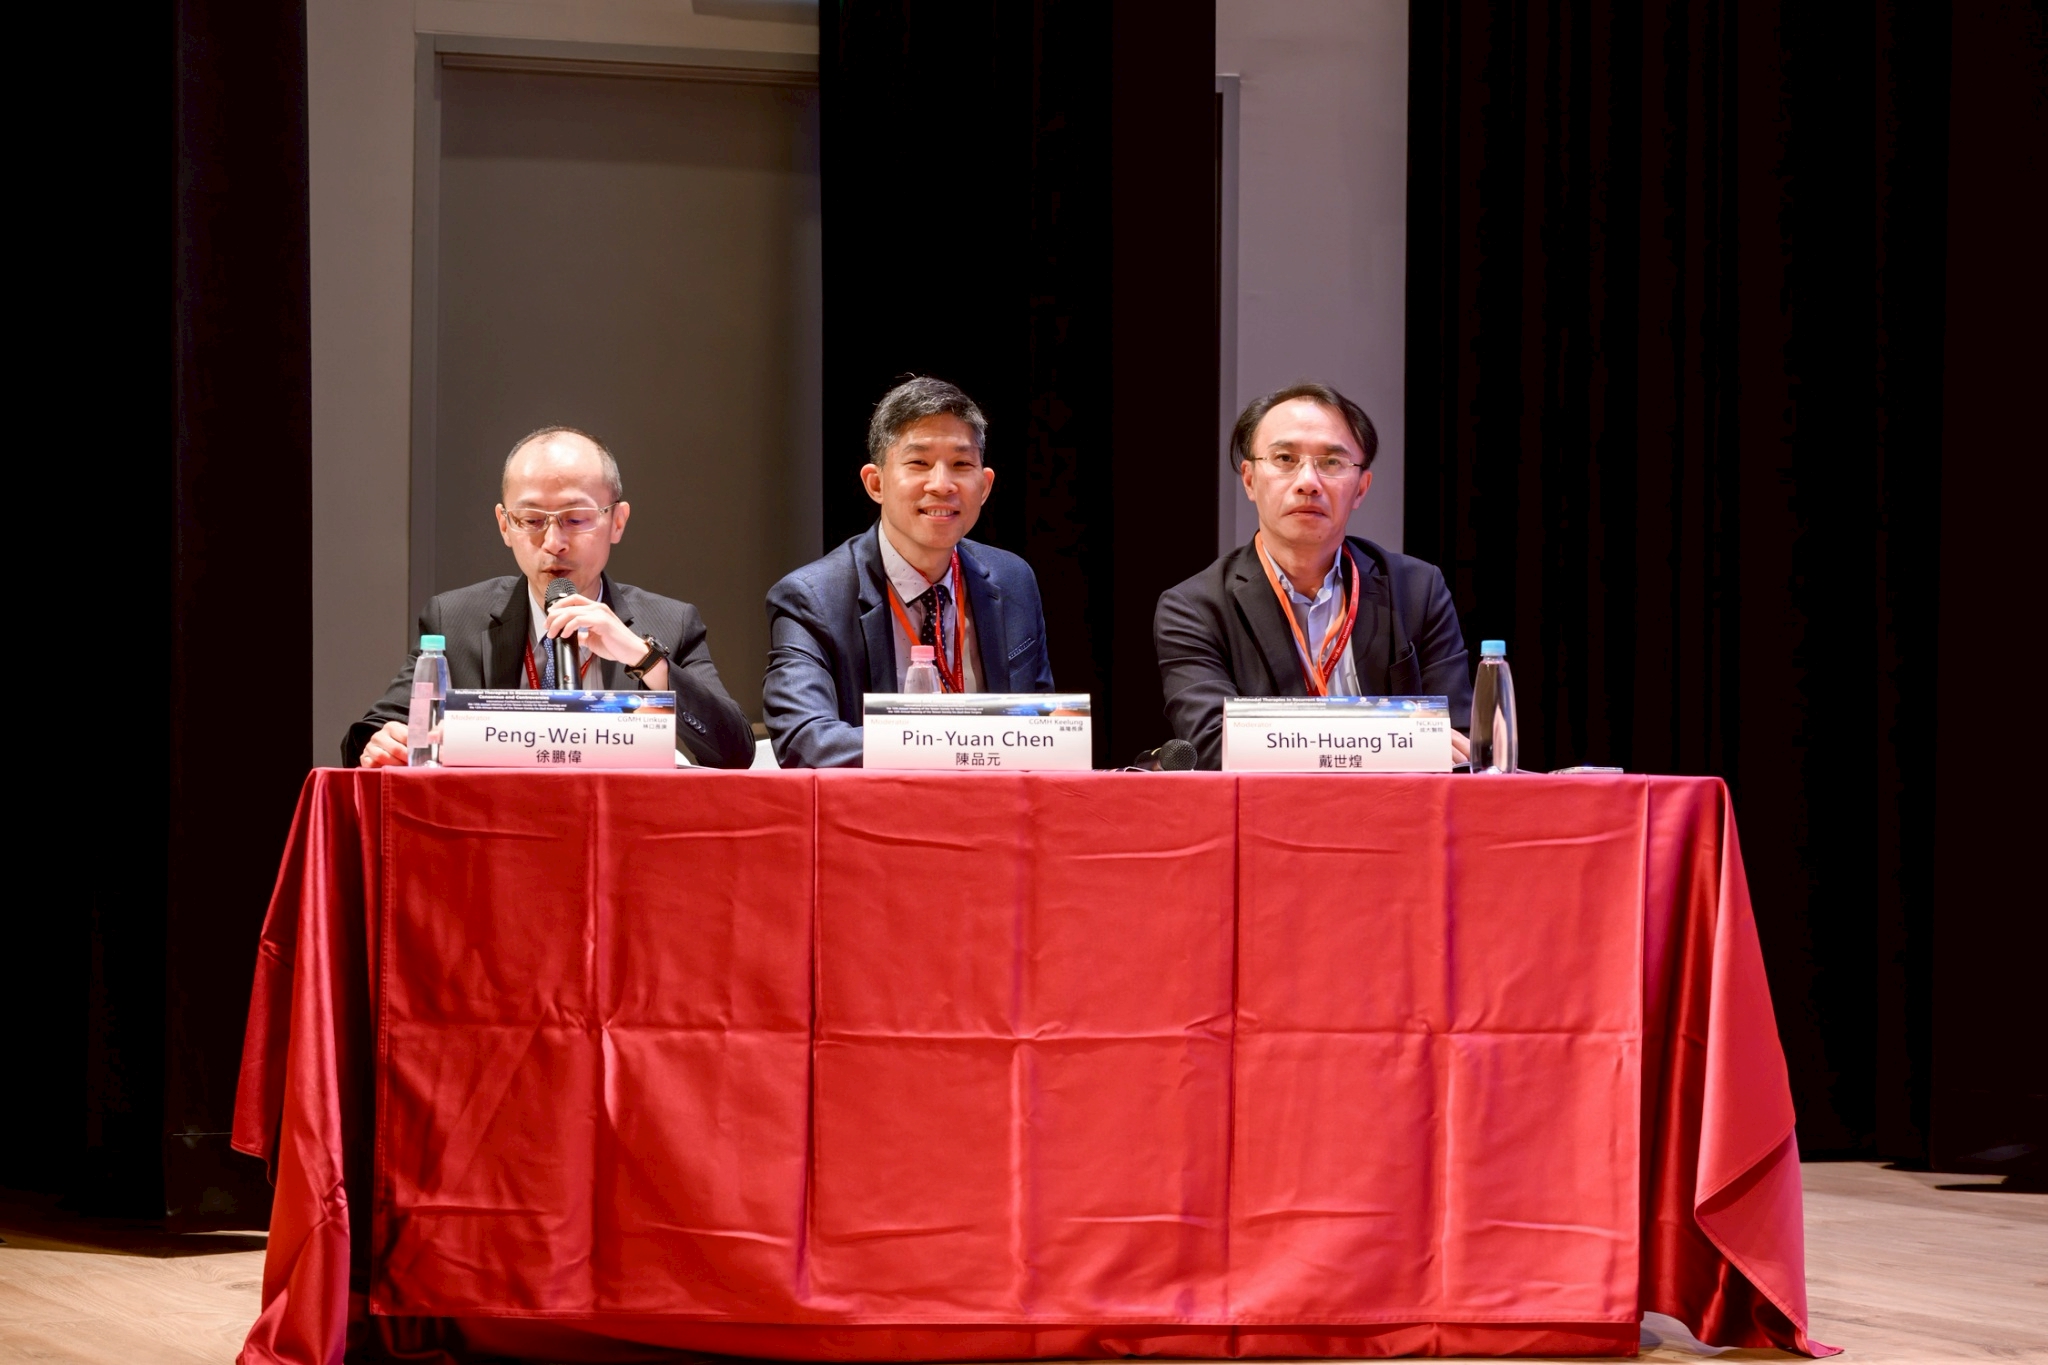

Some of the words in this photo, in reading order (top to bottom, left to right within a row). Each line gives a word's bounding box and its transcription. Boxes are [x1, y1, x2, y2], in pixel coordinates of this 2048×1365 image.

[485, 726, 587, 747] Peng-Wei
[596, 728, 634, 745] Hsu
[902, 730, 995, 747] Pin-Yuan
[1002, 730, 1055, 747] Chen
[1266, 732, 1382, 753] Shih-Huang
[1388, 732, 1413, 748] Tai
[536, 749, 582, 763] 徐鵬偉
[956, 752, 1001, 766] 陳品元
[1319, 754, 1363, 768] 戴世煌
